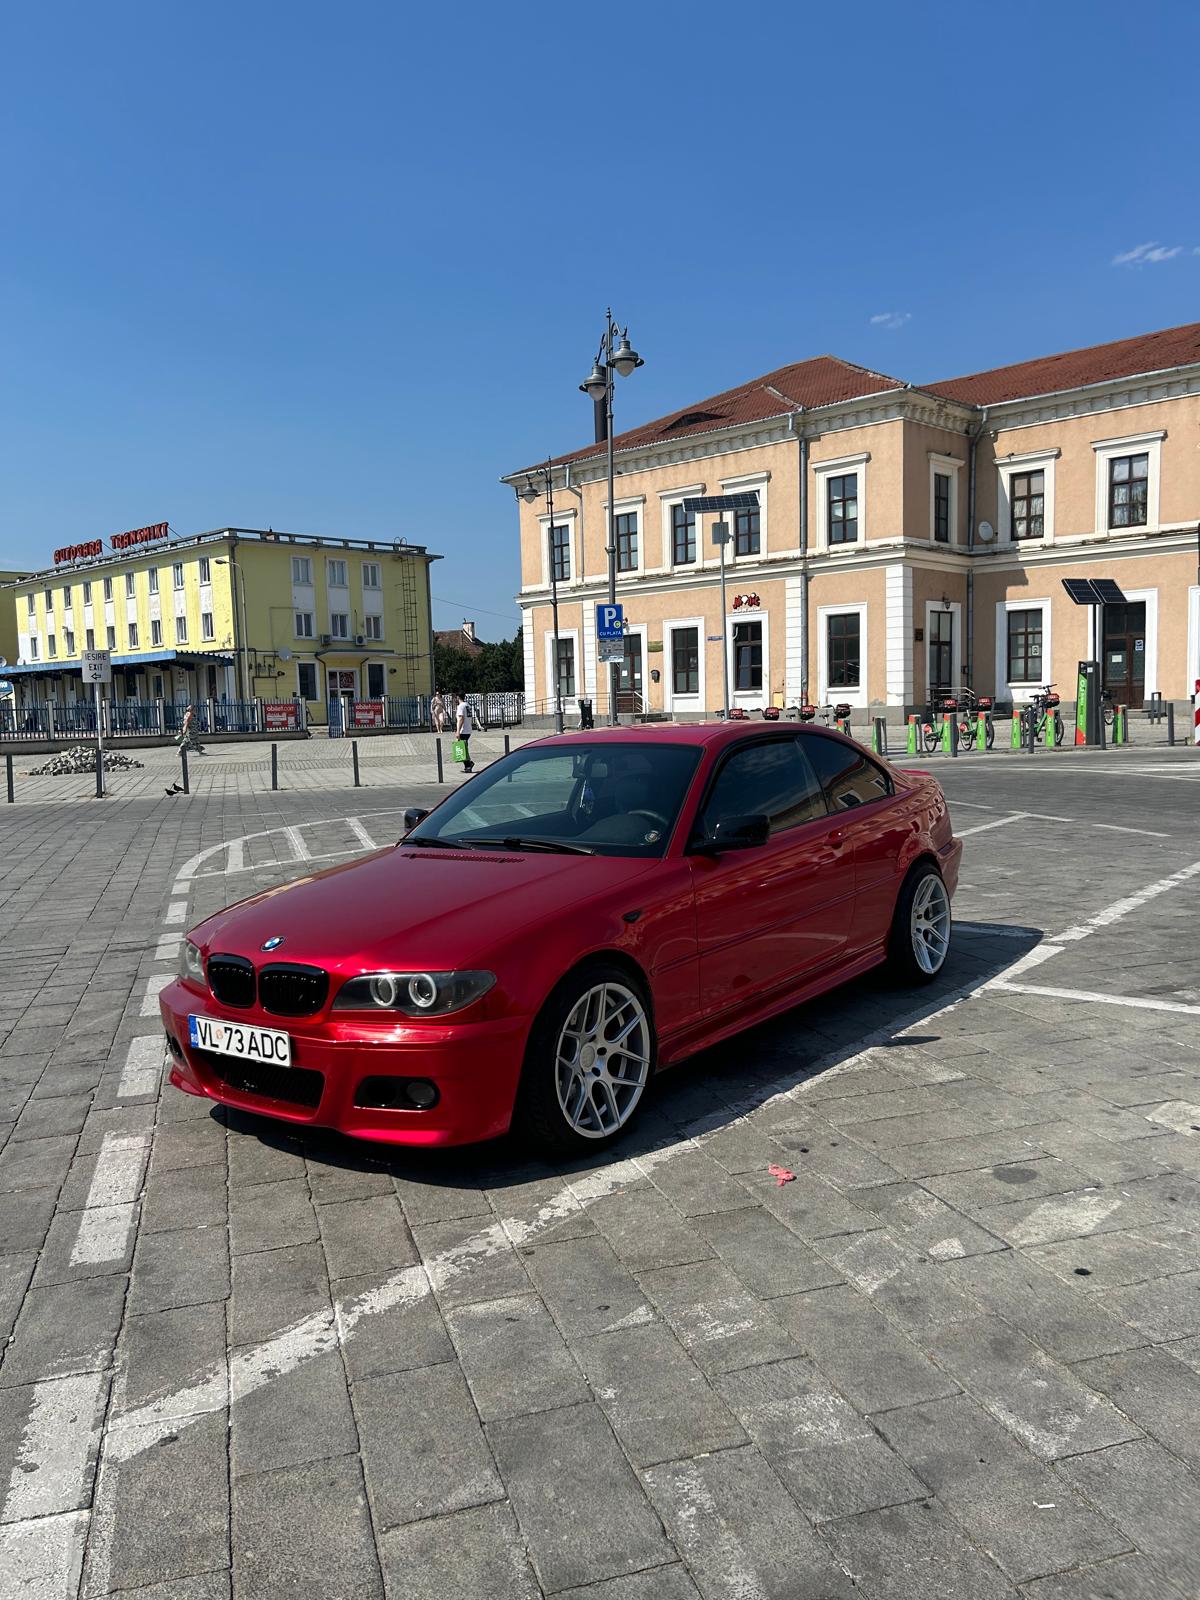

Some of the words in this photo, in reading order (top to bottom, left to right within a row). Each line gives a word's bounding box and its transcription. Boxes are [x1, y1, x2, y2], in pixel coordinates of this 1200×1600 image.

[604, 607, 617, 628] P
[88, 663, 103, 671] EXIT
[197, 1021, 219, 1048] VL
[224, 1026, 245, 1054] 73
[247, 1031, 288, 1061] ADC
